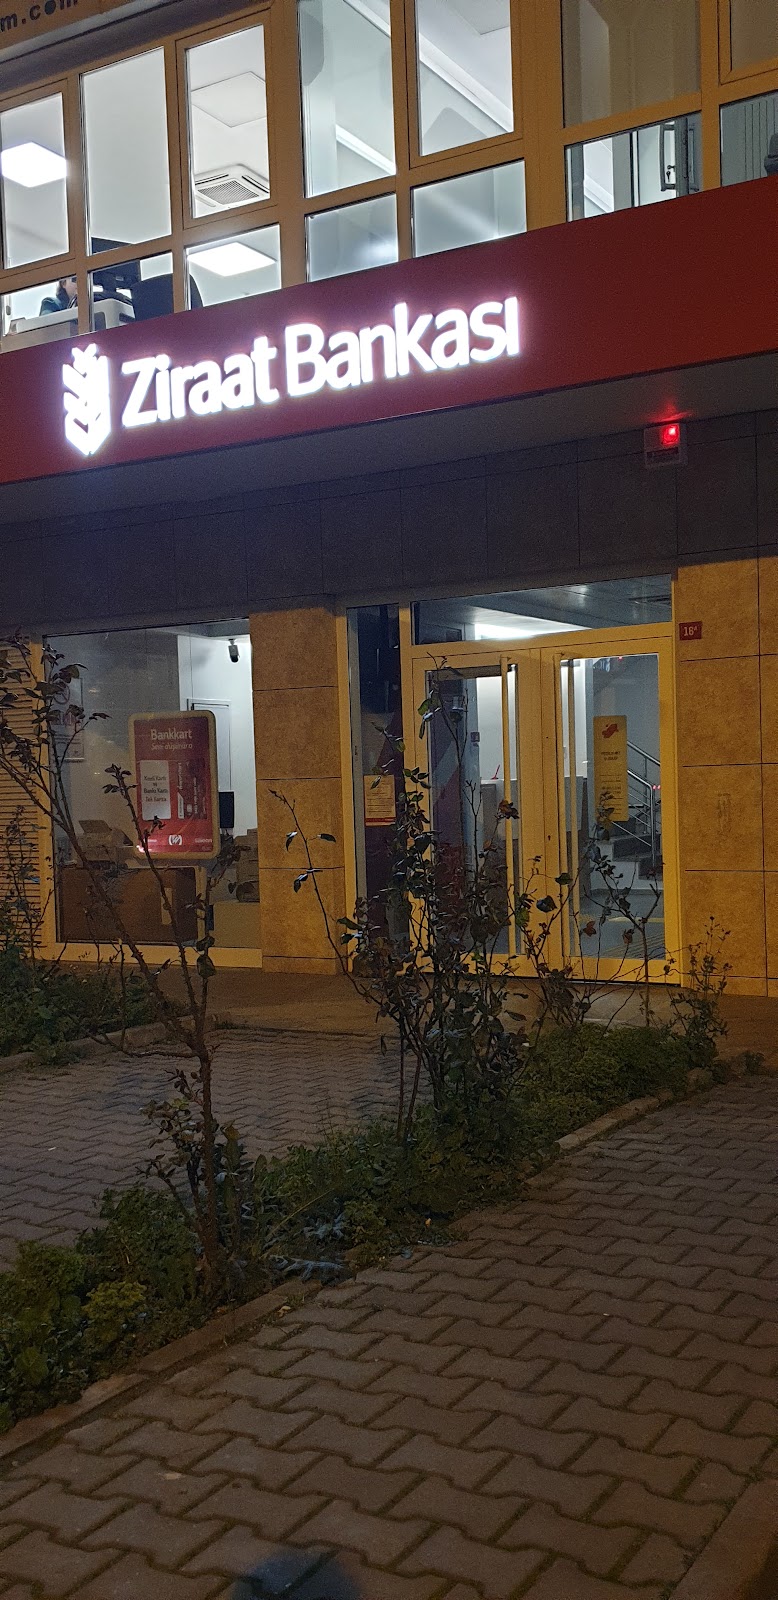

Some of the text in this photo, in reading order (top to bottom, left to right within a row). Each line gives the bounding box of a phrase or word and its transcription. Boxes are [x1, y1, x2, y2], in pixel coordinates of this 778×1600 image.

[121, 297, 520, 428] Ziraat Bankası
[151, 728, 193, 740] Bankkart
